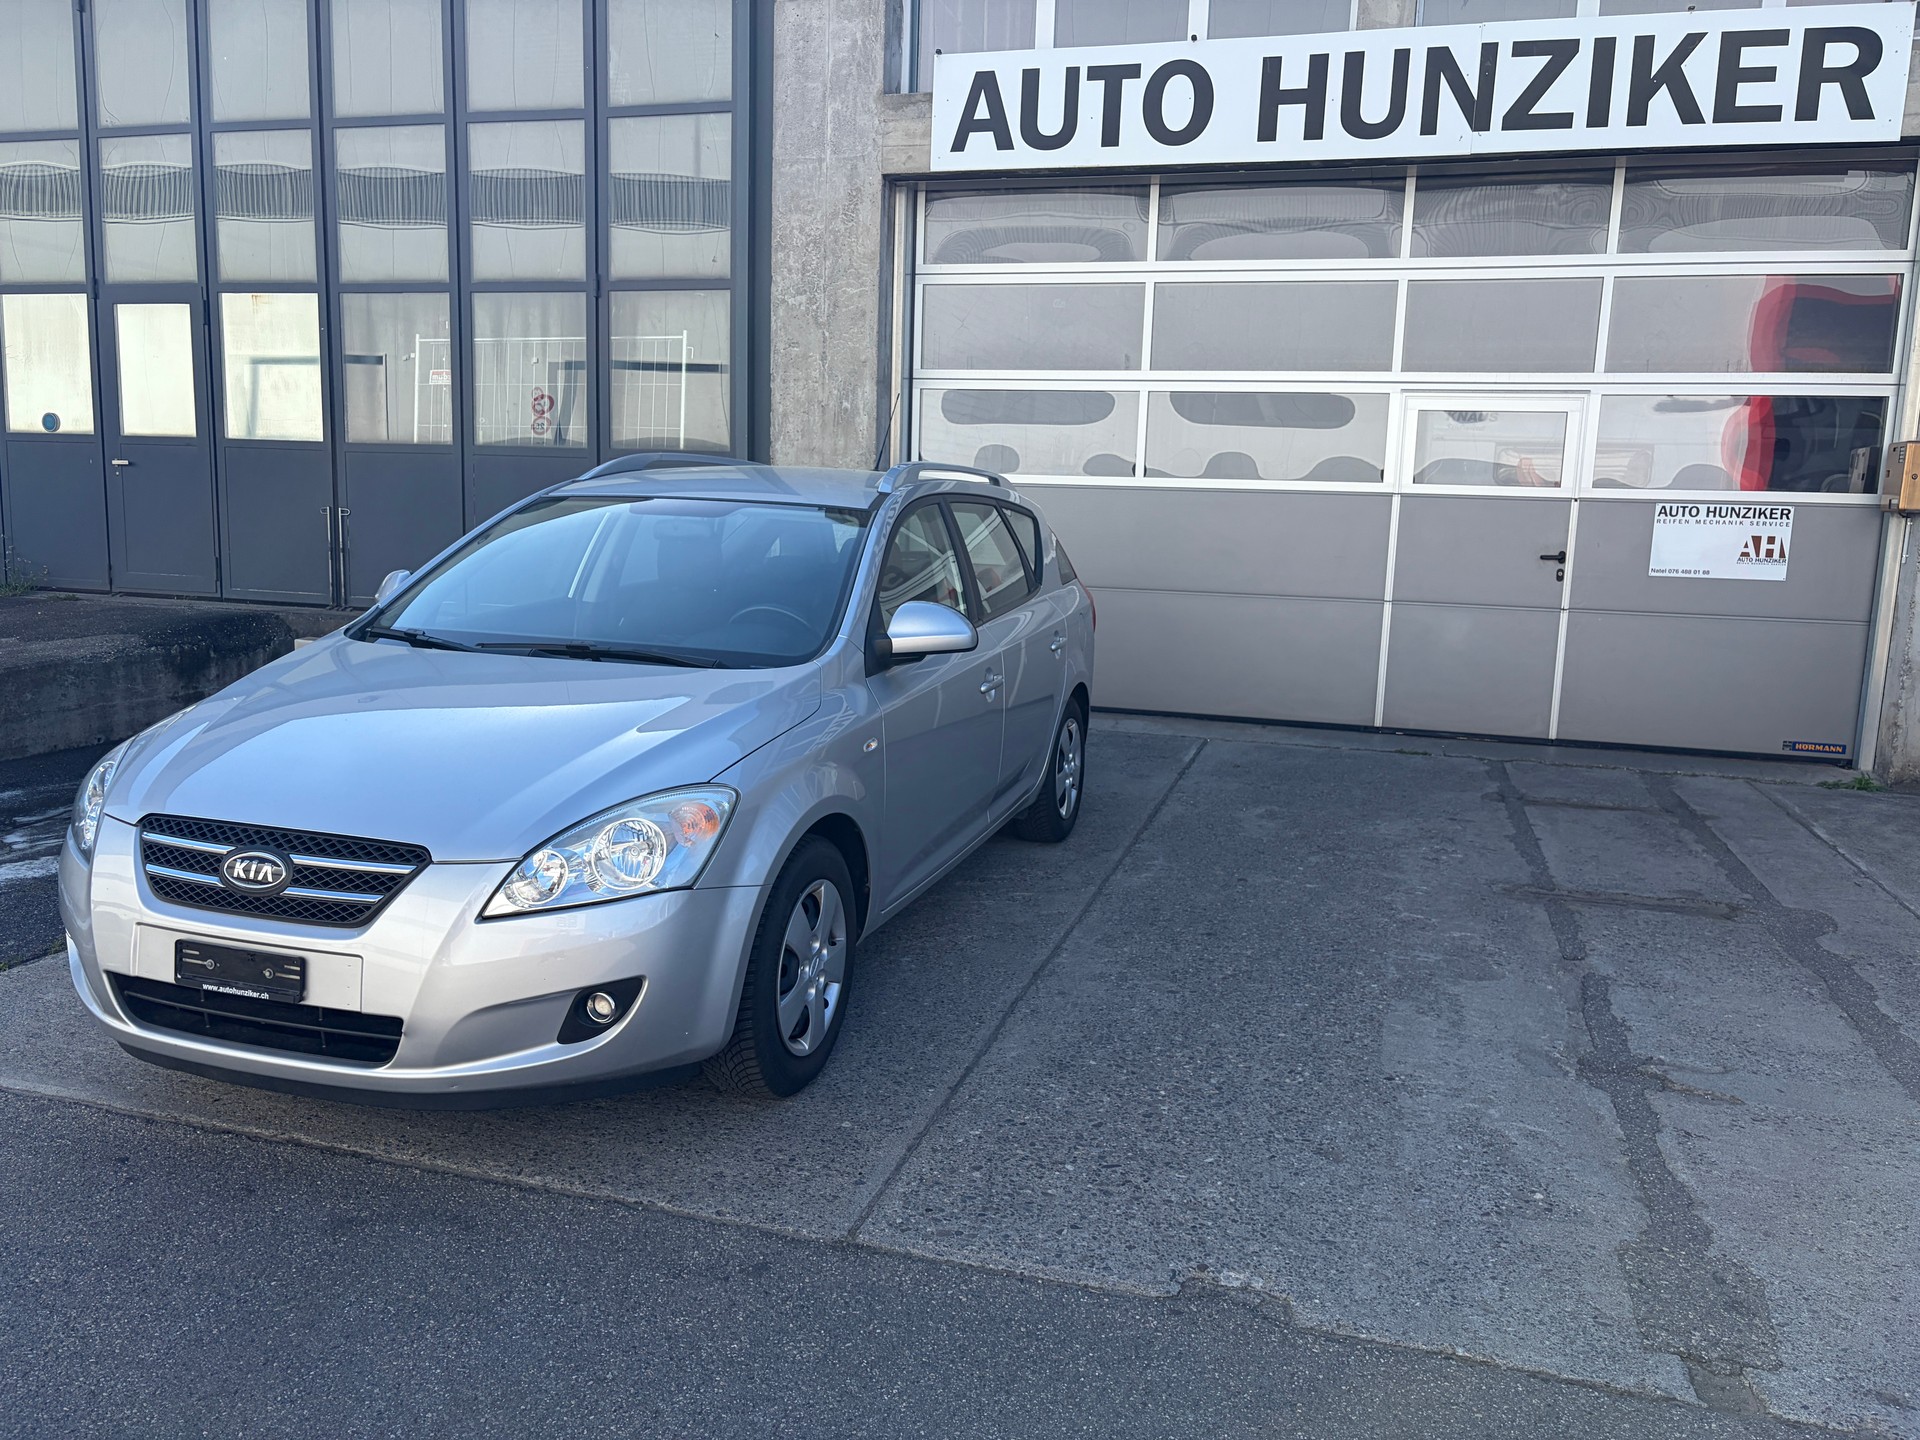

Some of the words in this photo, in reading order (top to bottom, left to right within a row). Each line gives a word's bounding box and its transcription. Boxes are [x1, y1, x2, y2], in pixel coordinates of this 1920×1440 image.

[950, 59, 1214, 152] AUTO
[1257, 26, 1882, 143] HUNZIKER
[1657, 505, 1700, 518] AUTO
[1706, 506, 1791, 520] HUNZIKER
[233, 859, 273, 882] KIA
[202, 984, 269, 999] www.autohunziker.ch
